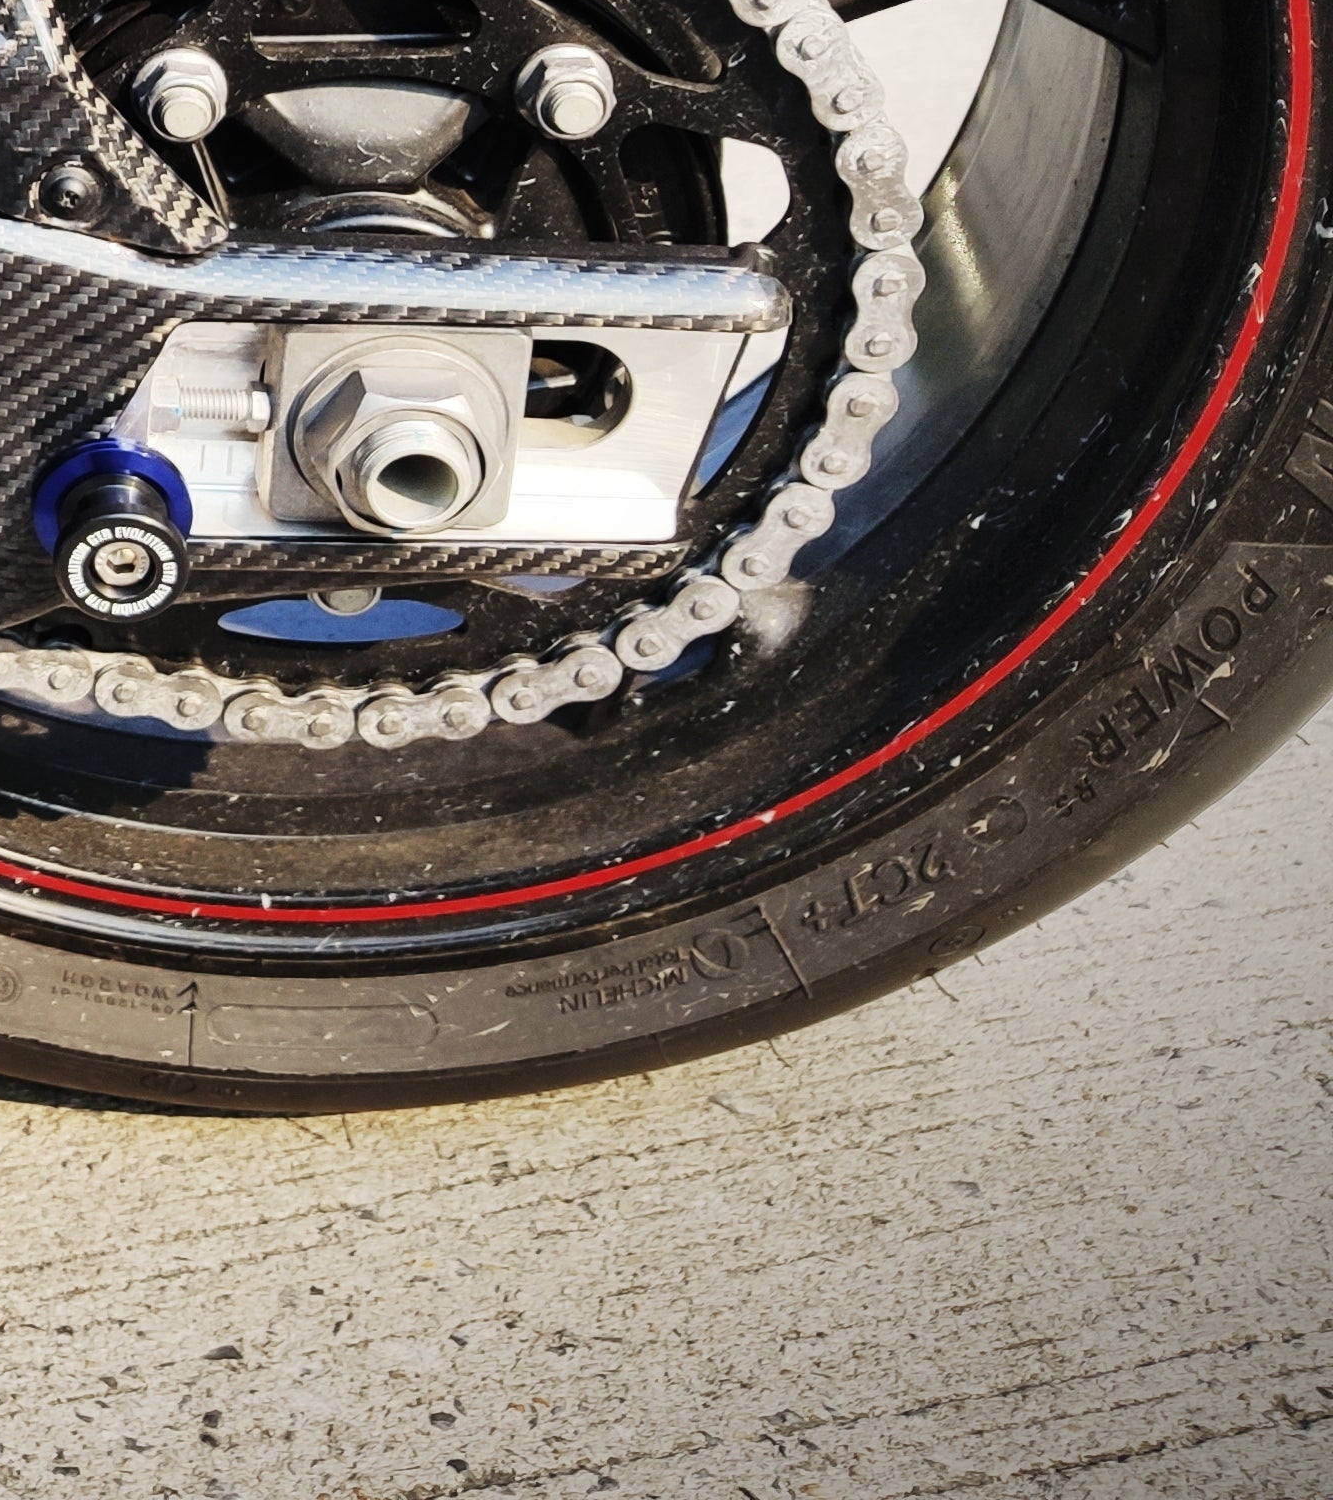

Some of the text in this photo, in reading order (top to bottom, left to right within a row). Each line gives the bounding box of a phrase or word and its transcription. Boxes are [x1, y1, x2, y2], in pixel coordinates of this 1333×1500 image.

[114, 525, 175, 562] EVOLUTION
[1083, 563, 1278, 770] POWER
[504, 947, 685, 998] Total Performance
[559, 965, 689, 1015] MICHELIN
